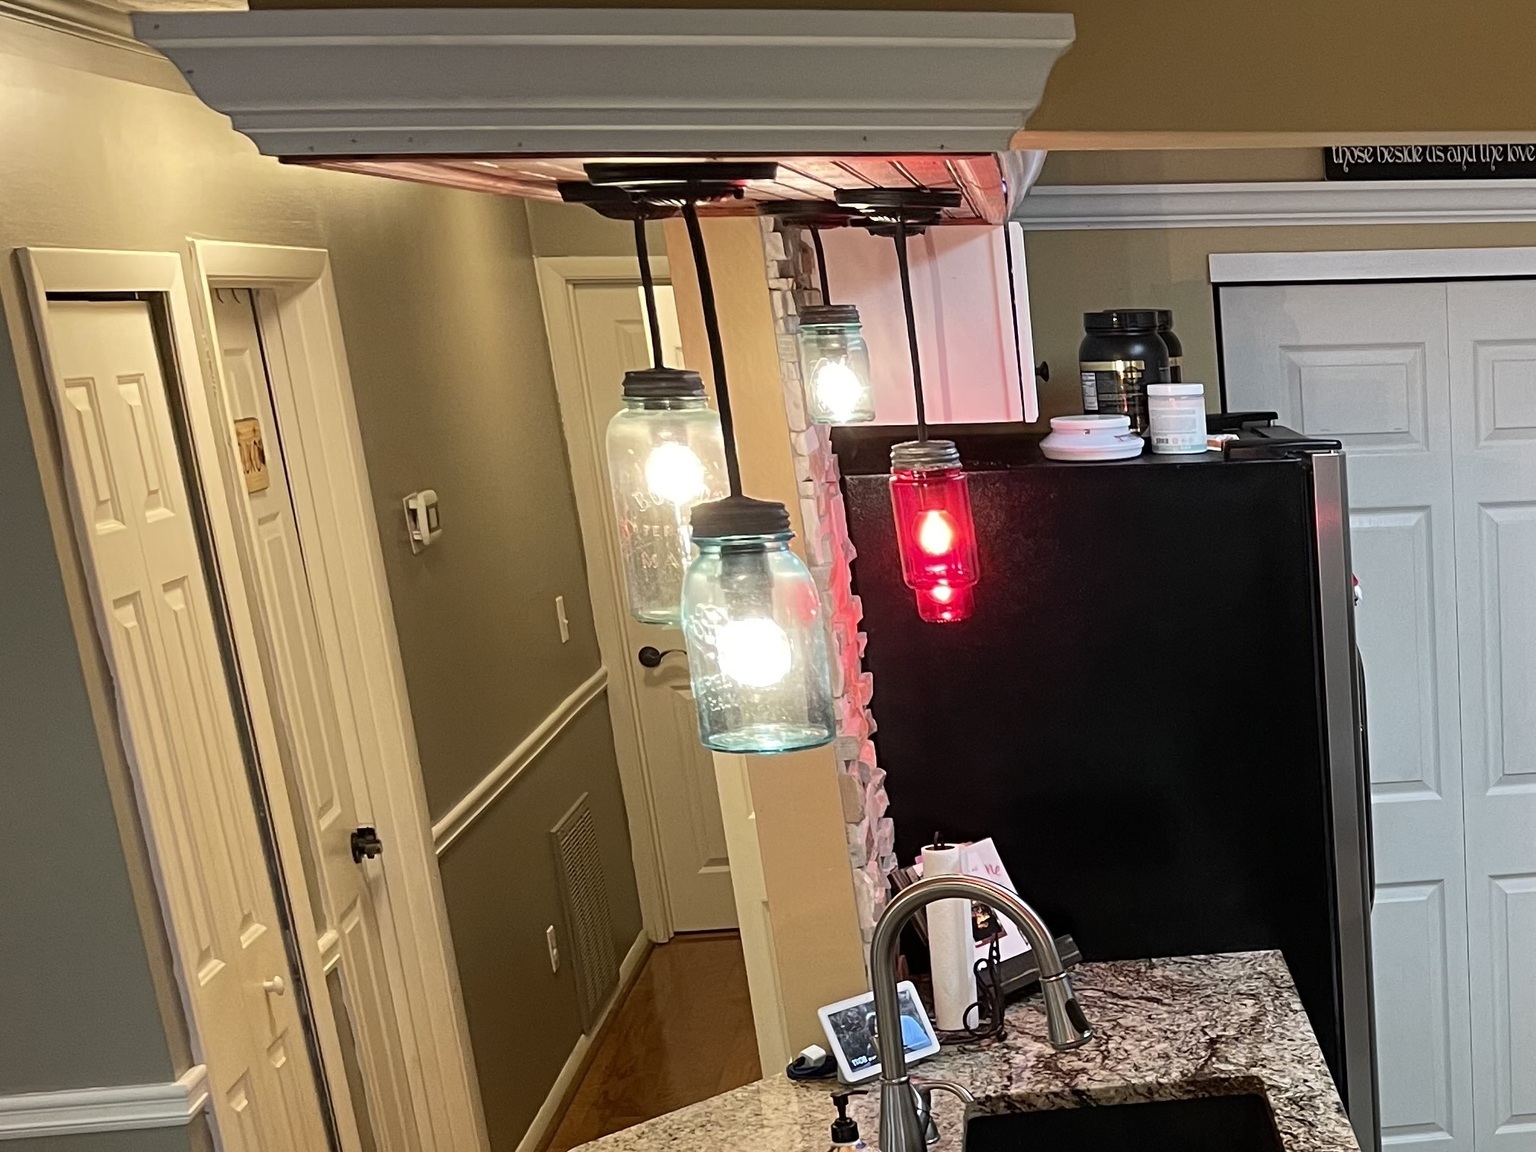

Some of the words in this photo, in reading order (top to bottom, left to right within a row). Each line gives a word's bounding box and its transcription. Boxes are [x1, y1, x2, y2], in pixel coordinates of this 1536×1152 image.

[1331, 145, 1374, 173] those
[1376, 144, 1424, 164] beside
[1425, 144, 1446, 164] us
[1447, 144, 1477, 171] and
[1479, 143, 1504, 171] the
[1506, 143, 1536, 163] love
